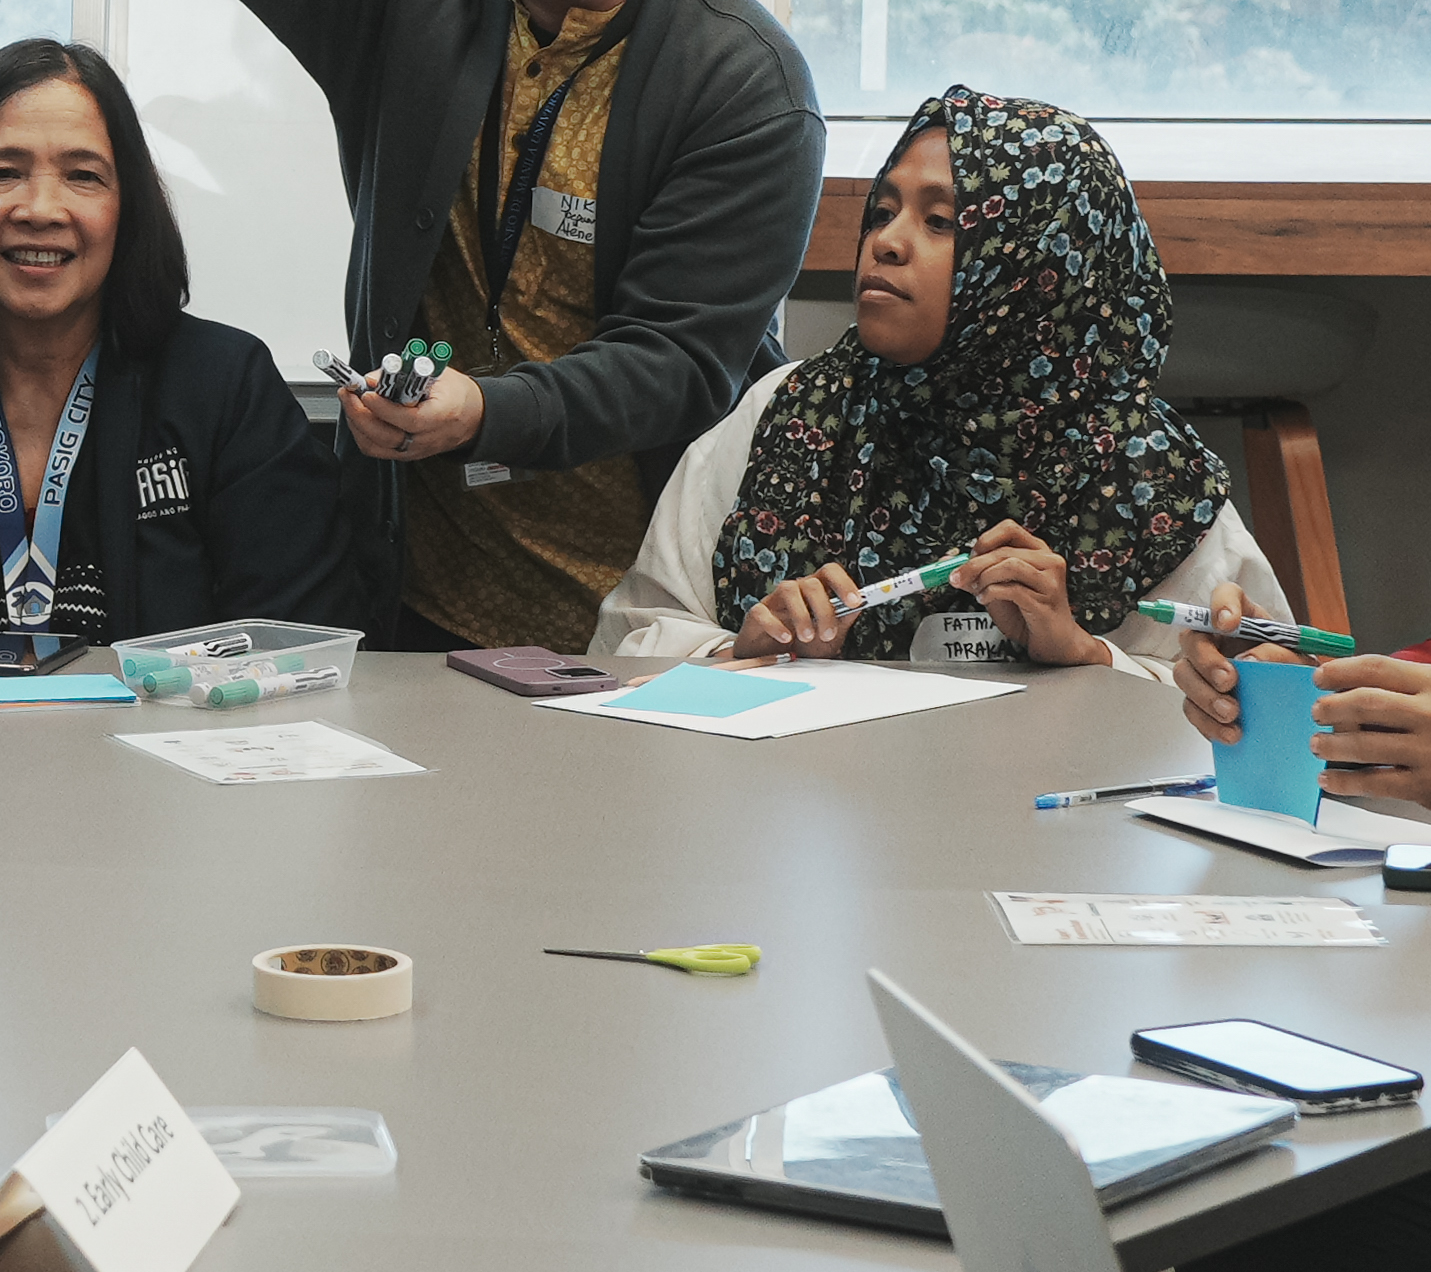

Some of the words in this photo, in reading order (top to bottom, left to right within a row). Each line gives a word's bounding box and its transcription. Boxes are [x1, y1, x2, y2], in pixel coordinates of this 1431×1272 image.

[555, 217, 594, 241] Atene
[43, 430, 80, 507] PASIG
[66, 372, 96, 425] CITY
[111, 1130, 152, 1183] Child
[137, 1115, 175, 1154] Care
[75, 1196, 100, 1227] 2.
[83, 1165, 131, 1216] Early
